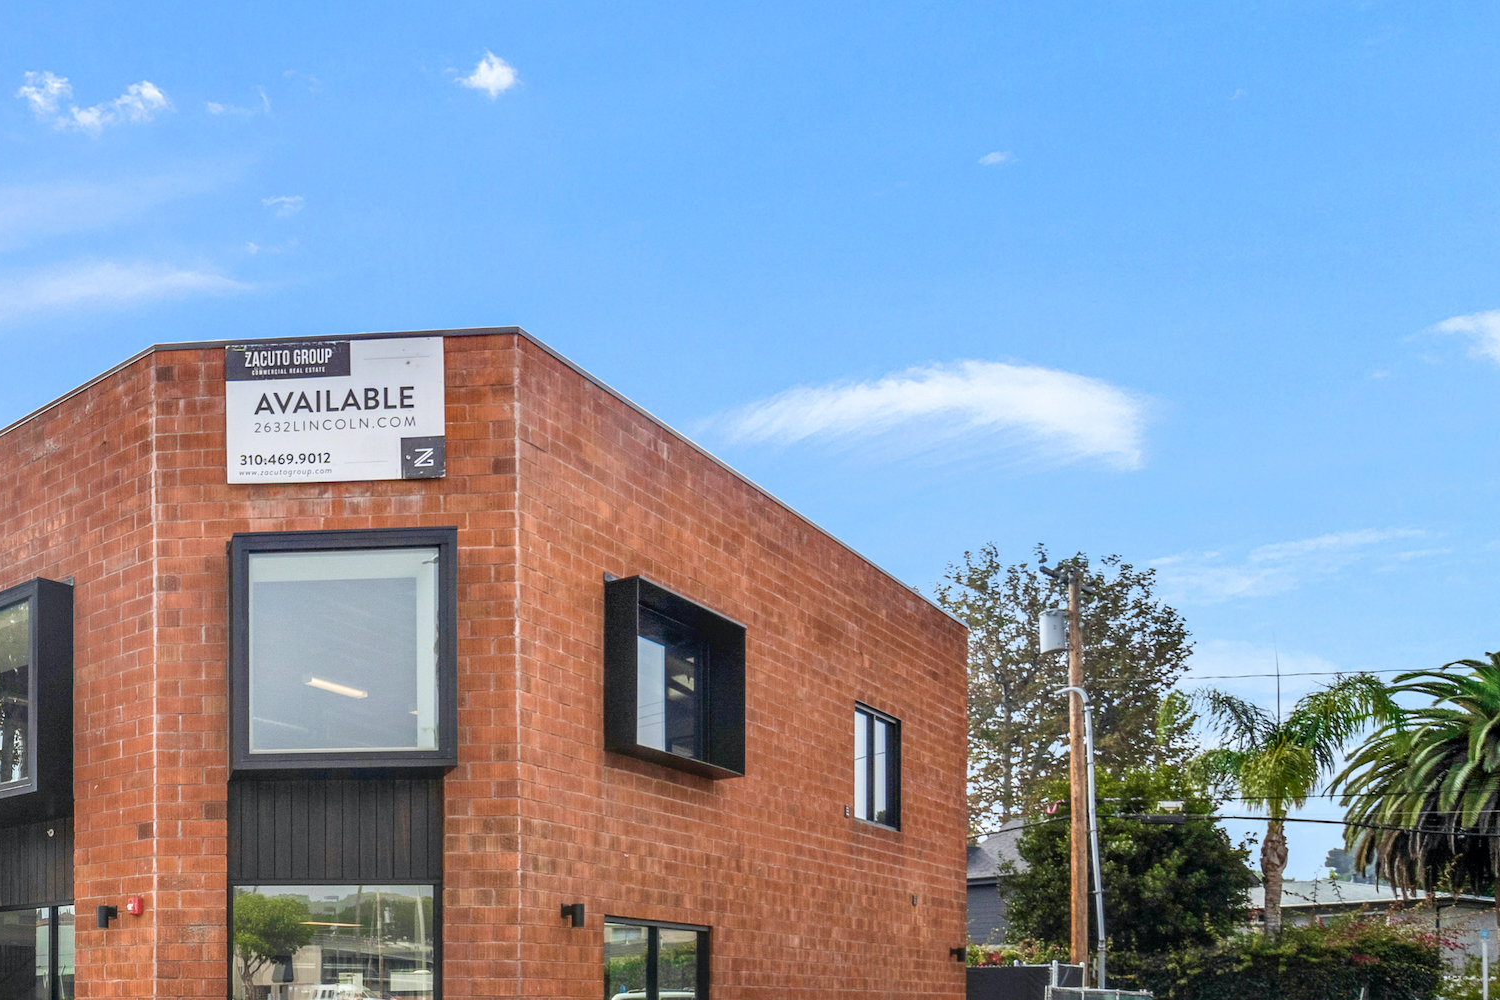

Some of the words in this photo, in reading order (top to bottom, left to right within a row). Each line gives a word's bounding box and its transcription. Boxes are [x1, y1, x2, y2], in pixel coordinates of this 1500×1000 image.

[244, 350, 290, 367] ZACUTO
[293, 348, 333, 365] GROUP
[251, 367, 287, 376] COMMERCIAL
[289, 367, 303, 375] REAL
[305, 366, 326, 374] ESTATE
[254, 386, 415, 415] AVAILABLE
[254, 416, 416, 433] 2632LINCOLN.COM
[239, 468, 332, 478] www.zacutogroup.com
